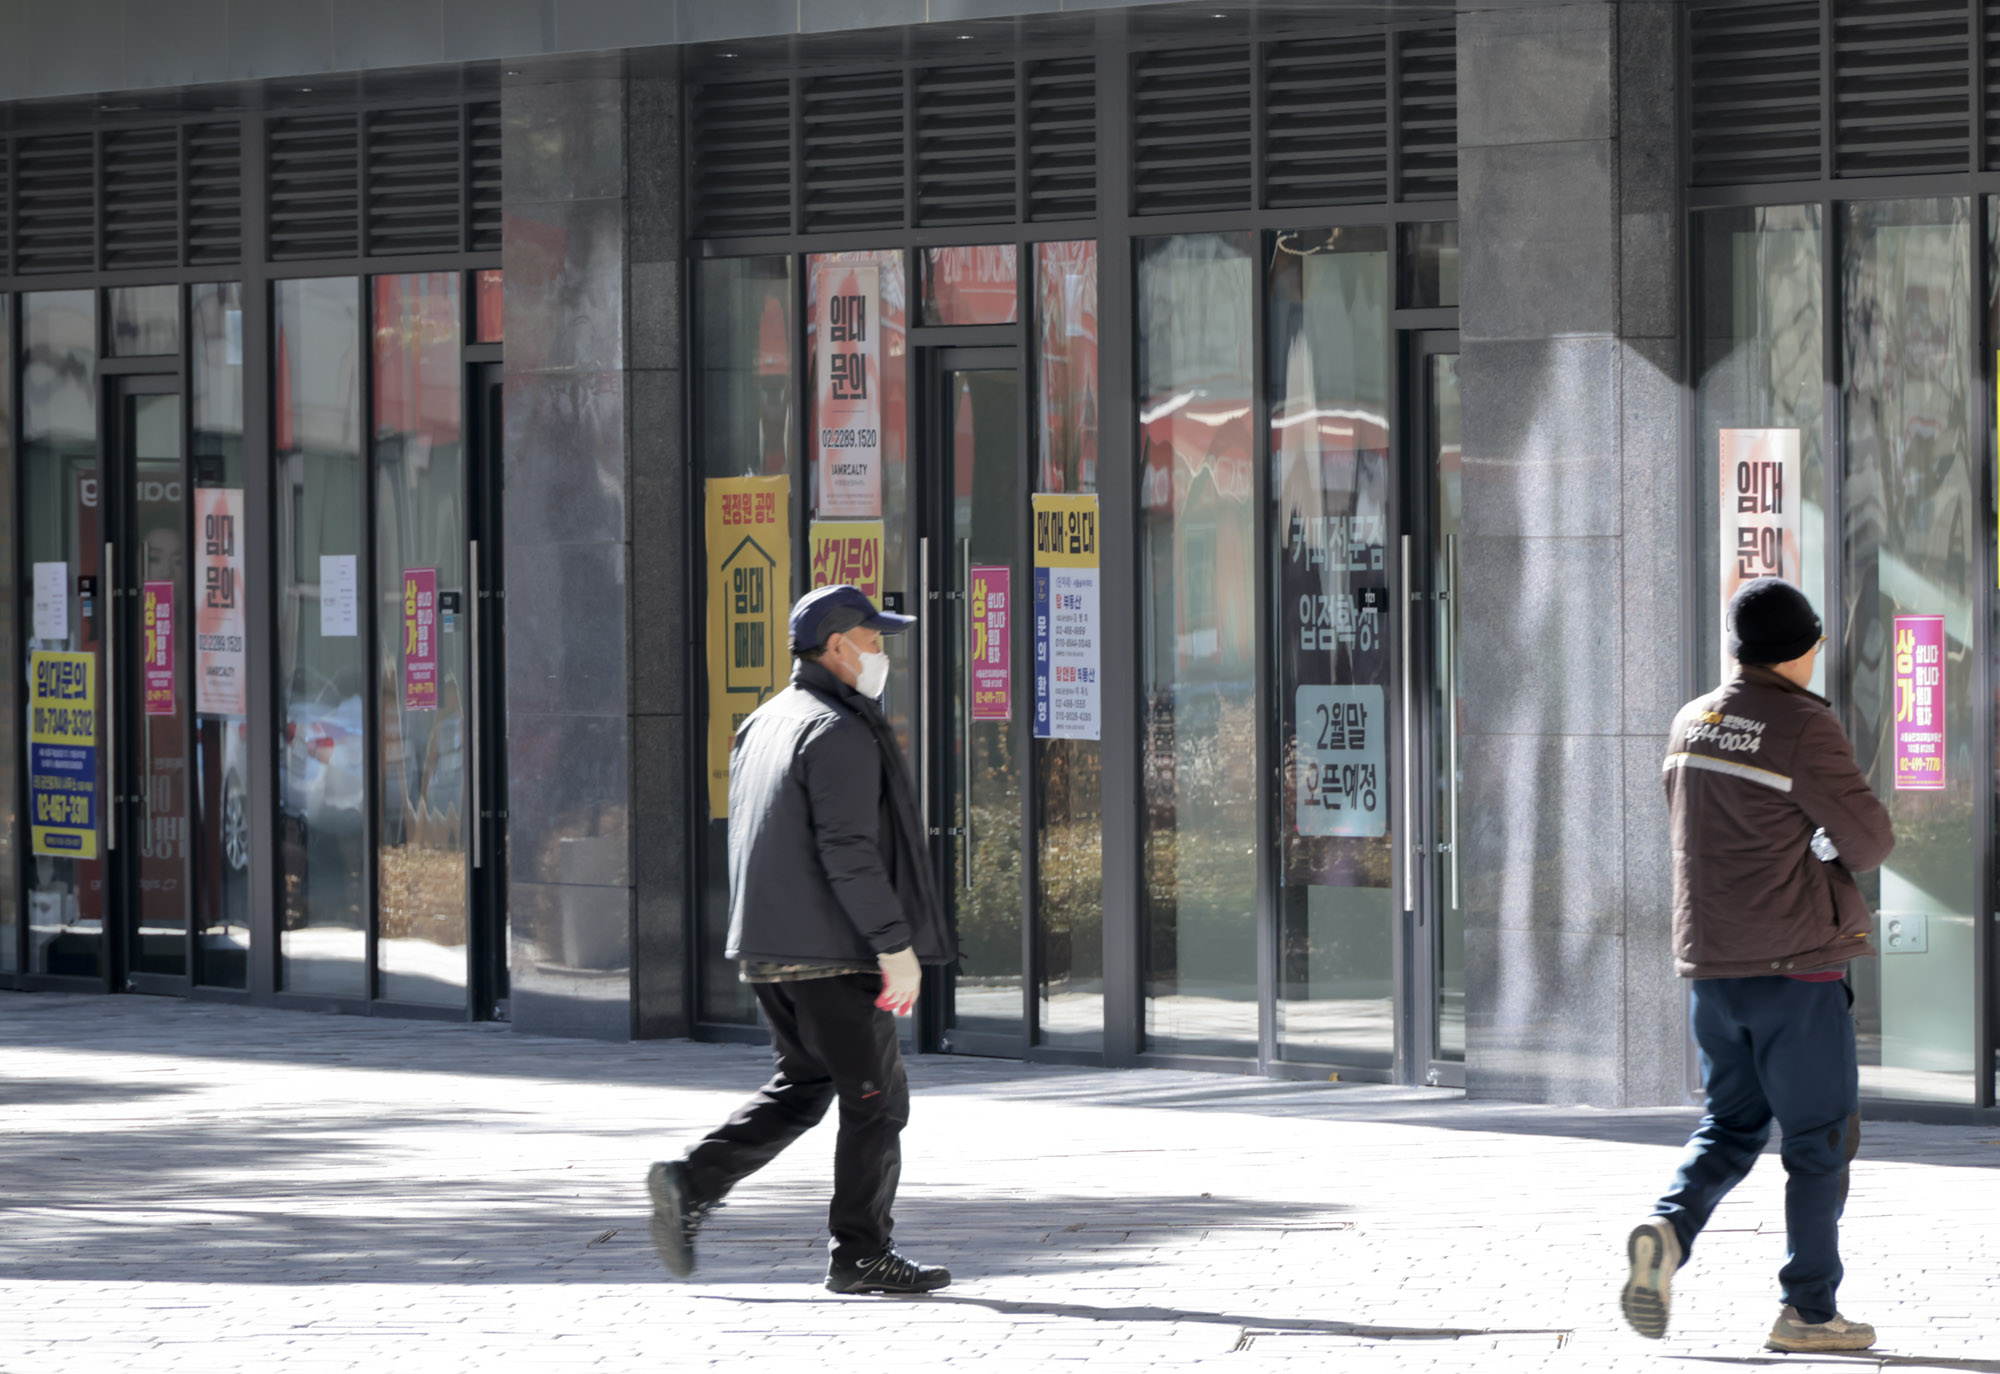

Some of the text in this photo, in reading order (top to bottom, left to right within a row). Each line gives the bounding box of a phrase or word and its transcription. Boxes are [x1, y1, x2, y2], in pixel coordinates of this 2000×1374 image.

[830, 295, 866, 342] 임대
[830, 353, 867, 400] 문의
[822, 429, 877, 448] 02.2289.1520
[755, 492, 775, 523] 공인
[1737, 461, 1783, 514] 임대
[206, 515, 234, 557] 임대
[1038, 511, 1094, 554] 매매·임대
[1292, 515, 1384, 571] 커피전문점
[1737, 527, 1783, 579] 문의
[206, 567, 234, 608] 문의
[734, 567, 764, 614] 임대
[145, 591, 157, 664] 상가
[404, 580, 418, 655] 상가
[973, 579, 987, 661] 상가
[1037, 615, 1047, 661] 문의
[735, 622, 764, 668] 매매
[38, 661, 86, 700] 임대문의
[1896, 628, 1916, 723] 상가
[1316, 703, 1367, 751] 2월말
[1684, 724, 1762, 754] 1544-0024
[1304, 763, 1377, 812] 오픈예정
